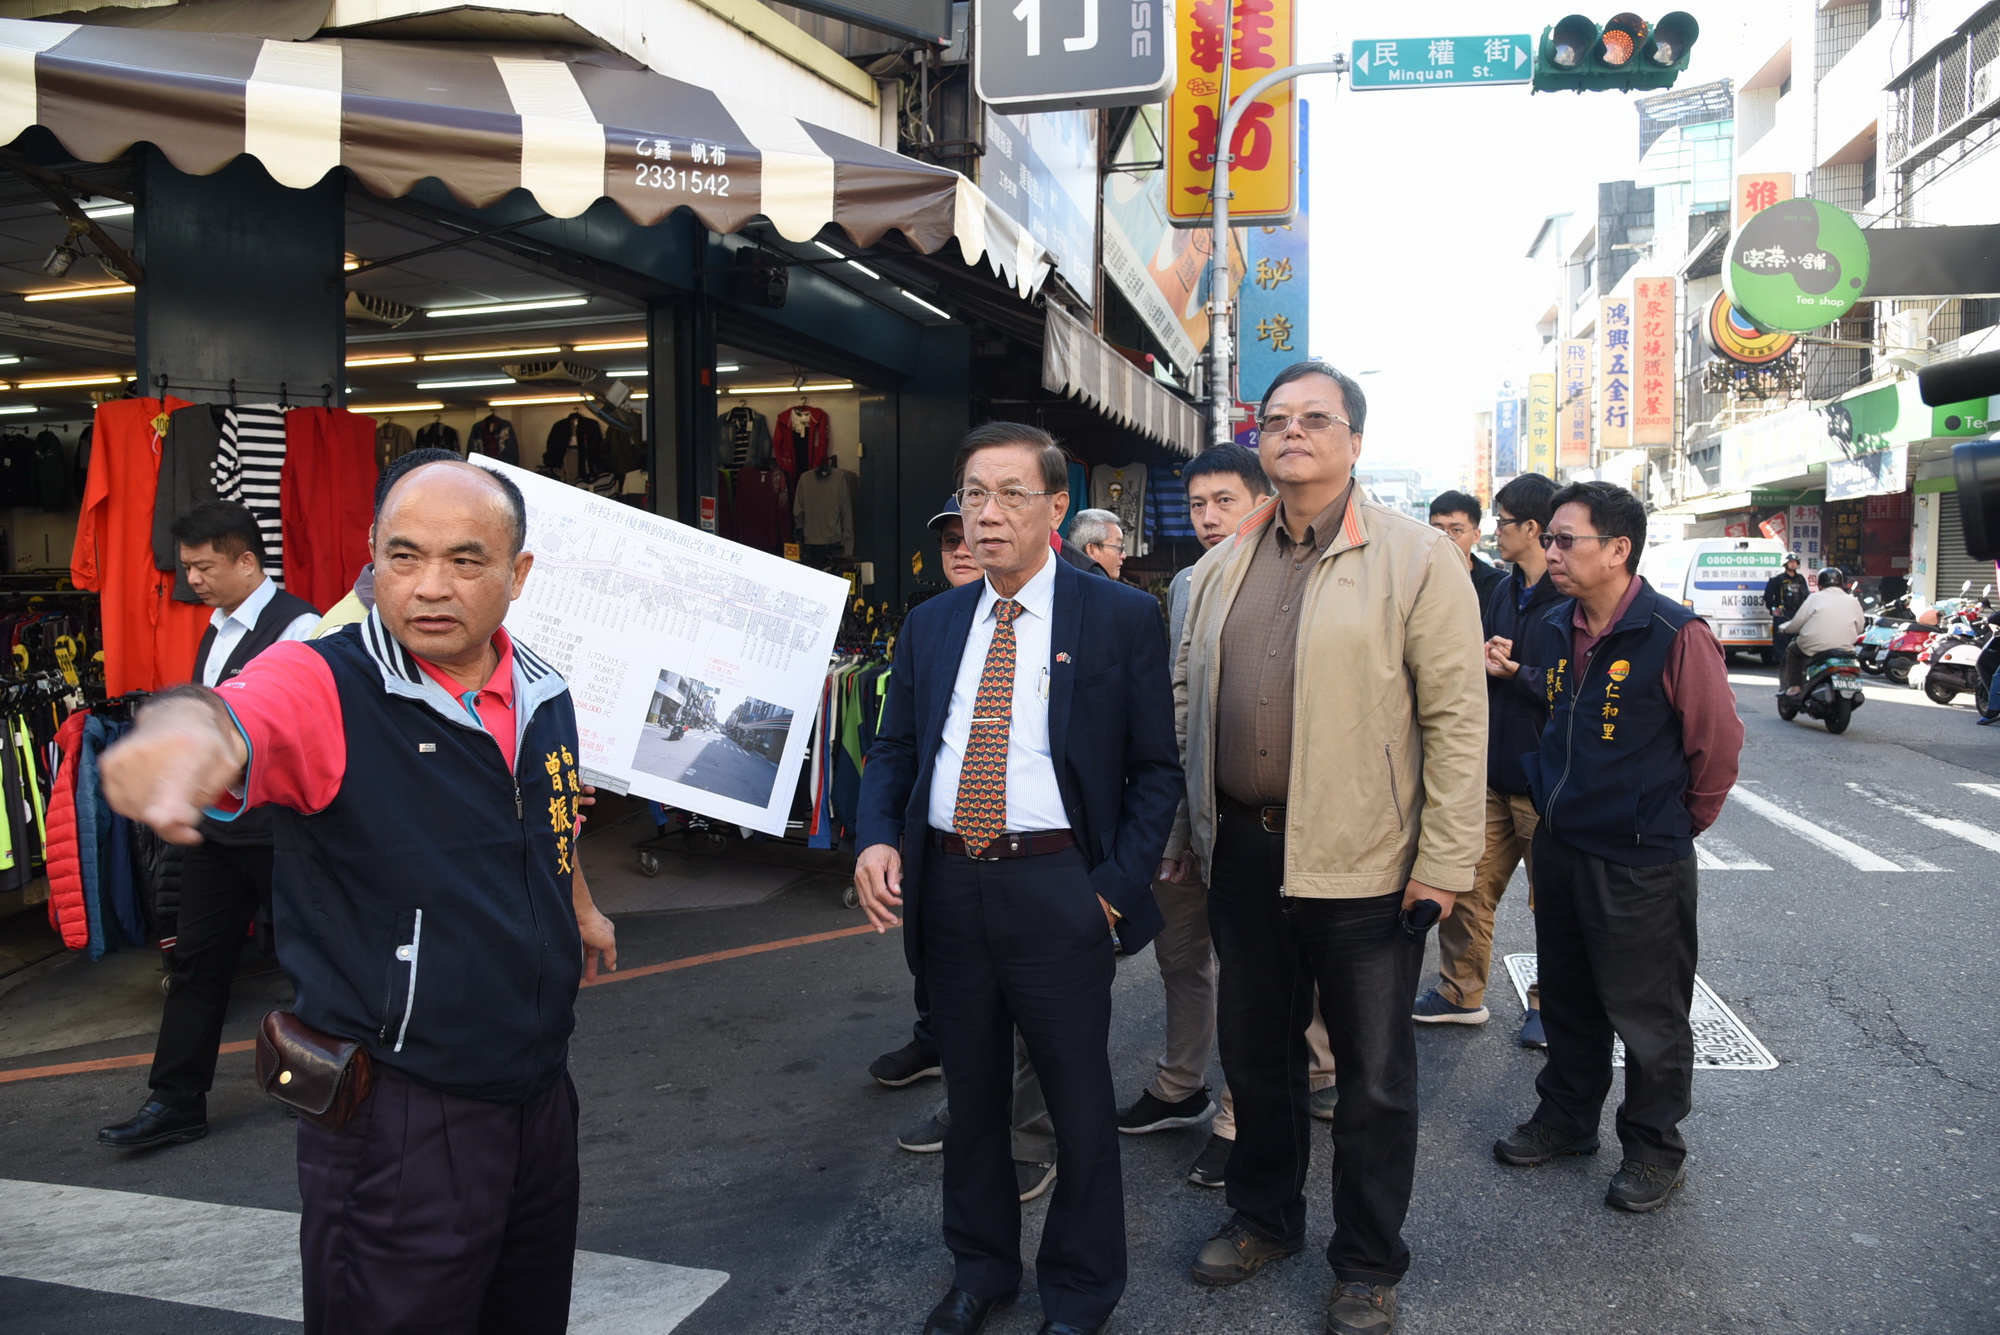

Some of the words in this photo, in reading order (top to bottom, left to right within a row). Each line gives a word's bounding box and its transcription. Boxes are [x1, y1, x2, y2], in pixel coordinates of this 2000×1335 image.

[1373, 38, 1511, 67] 民權街
[1388, 69, 1454, 83] Minquan
[1472, 65, 1494, 78] St.
[691, 142, 727, 166] 帆布
[635, 163, 730, 197] 2331542
[1637, 281, 1671, 299] 香港
[1796, 294, 1815, 305] Tea
[1818, 296, 1845, 308] shop
[1604, 302, 1630, 429] 鴻興五金行
[583, 501, 744, 567] 南投市復興路路面改善工程
[1721, 595, 1765, 607] AKT-3083
[620, 660, 630, 670] 元
[616, 670, 625, 680] 元
[614, 680, 623, 690] 元
[610, 689, 620, 700] 元
[607, 700, 616, 709] 元
[1601, 682, 1620, 740] 仁和里
[602, 709, 612, 719] 元
[544, 751, 573, 875] 曾振炎
